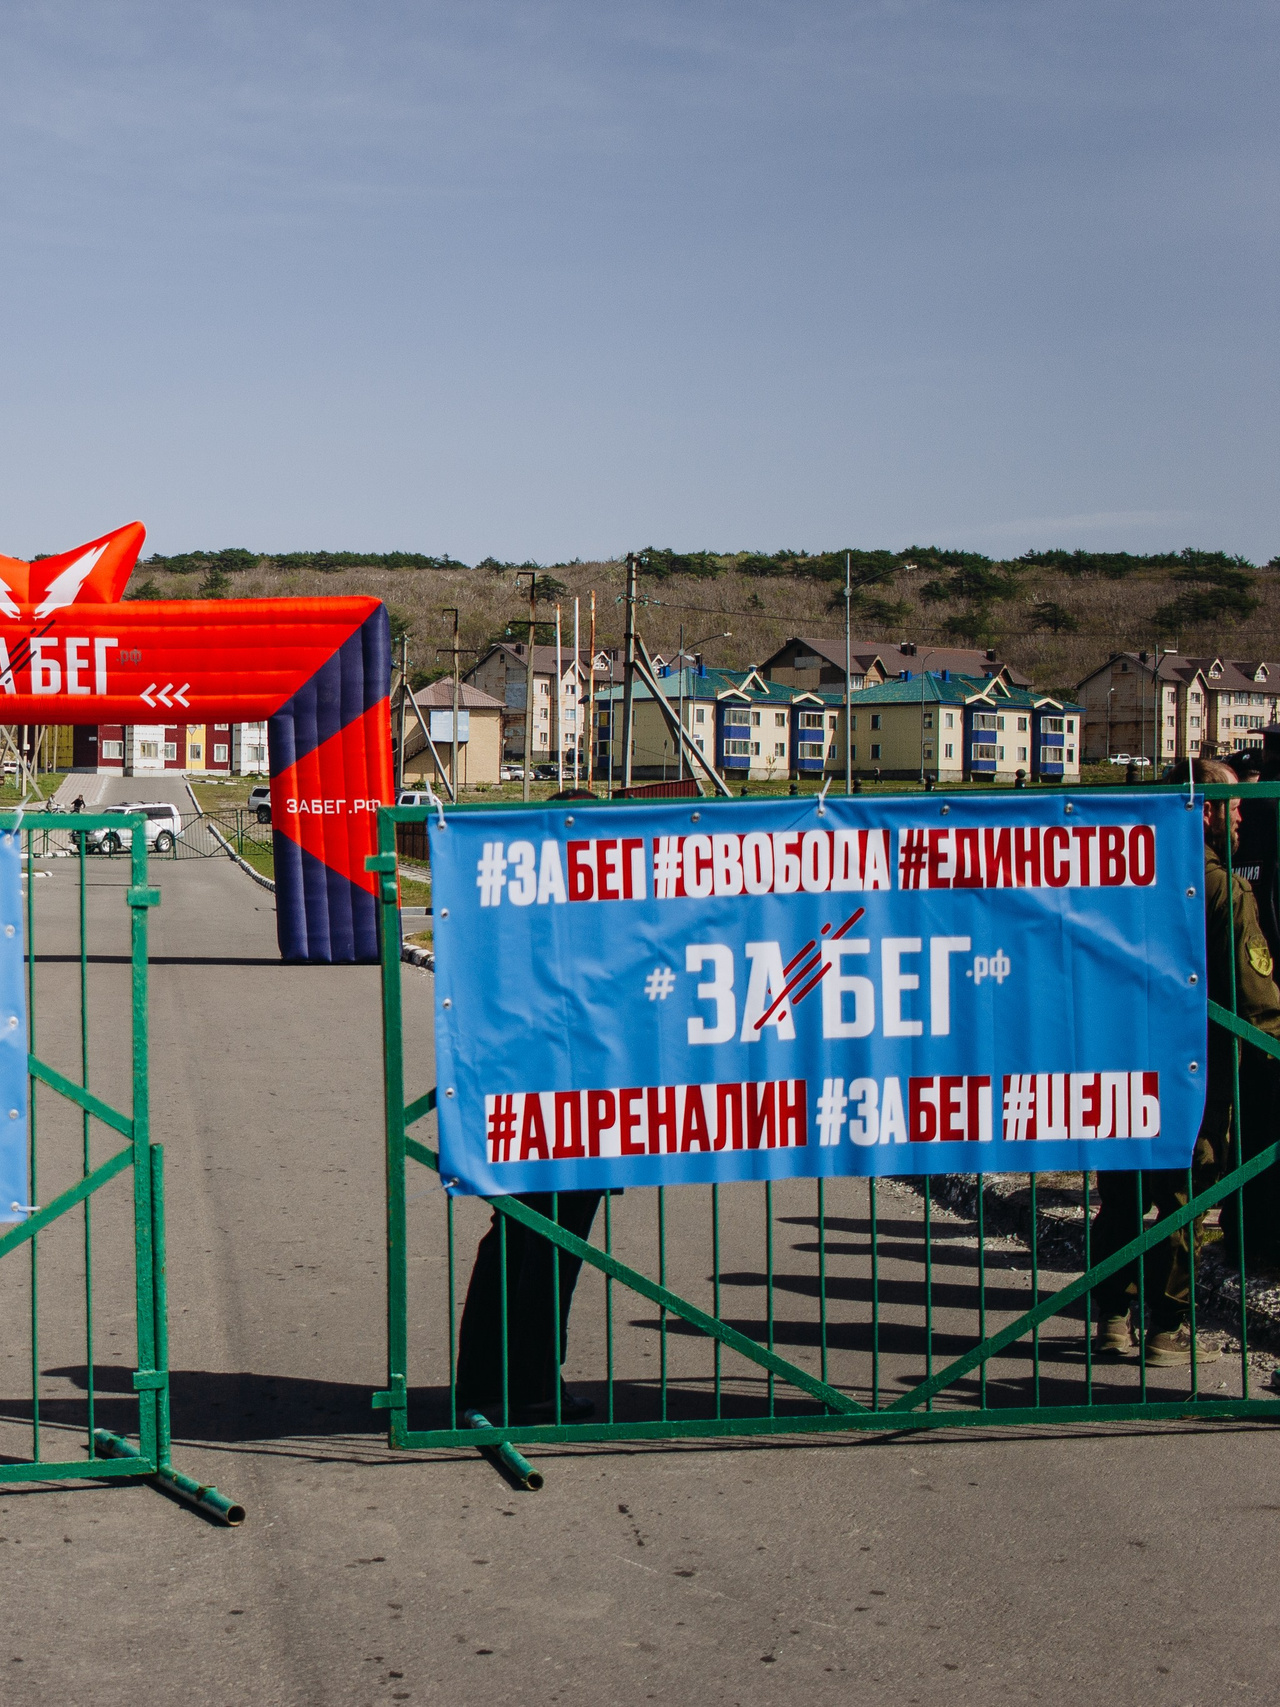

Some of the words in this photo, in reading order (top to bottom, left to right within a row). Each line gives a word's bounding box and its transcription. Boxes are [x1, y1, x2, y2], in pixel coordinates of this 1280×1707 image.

[286, 798, 382, 815] ЗАБЕГ.РФ
[476, 838, 646, 907] #ЗАБЕГ
[653, 829, 891, 898] #СВОБОДА
[899, 825, 1156, 890] #ЕДИНСТВО
[486, 1080, 807, 1163] #АДРЕНАЛИН
[816, 1075, 992, 1147] #ЗАБЕГ
[1002, 1071, 1161, 1142] #ЦЕЛЬ
